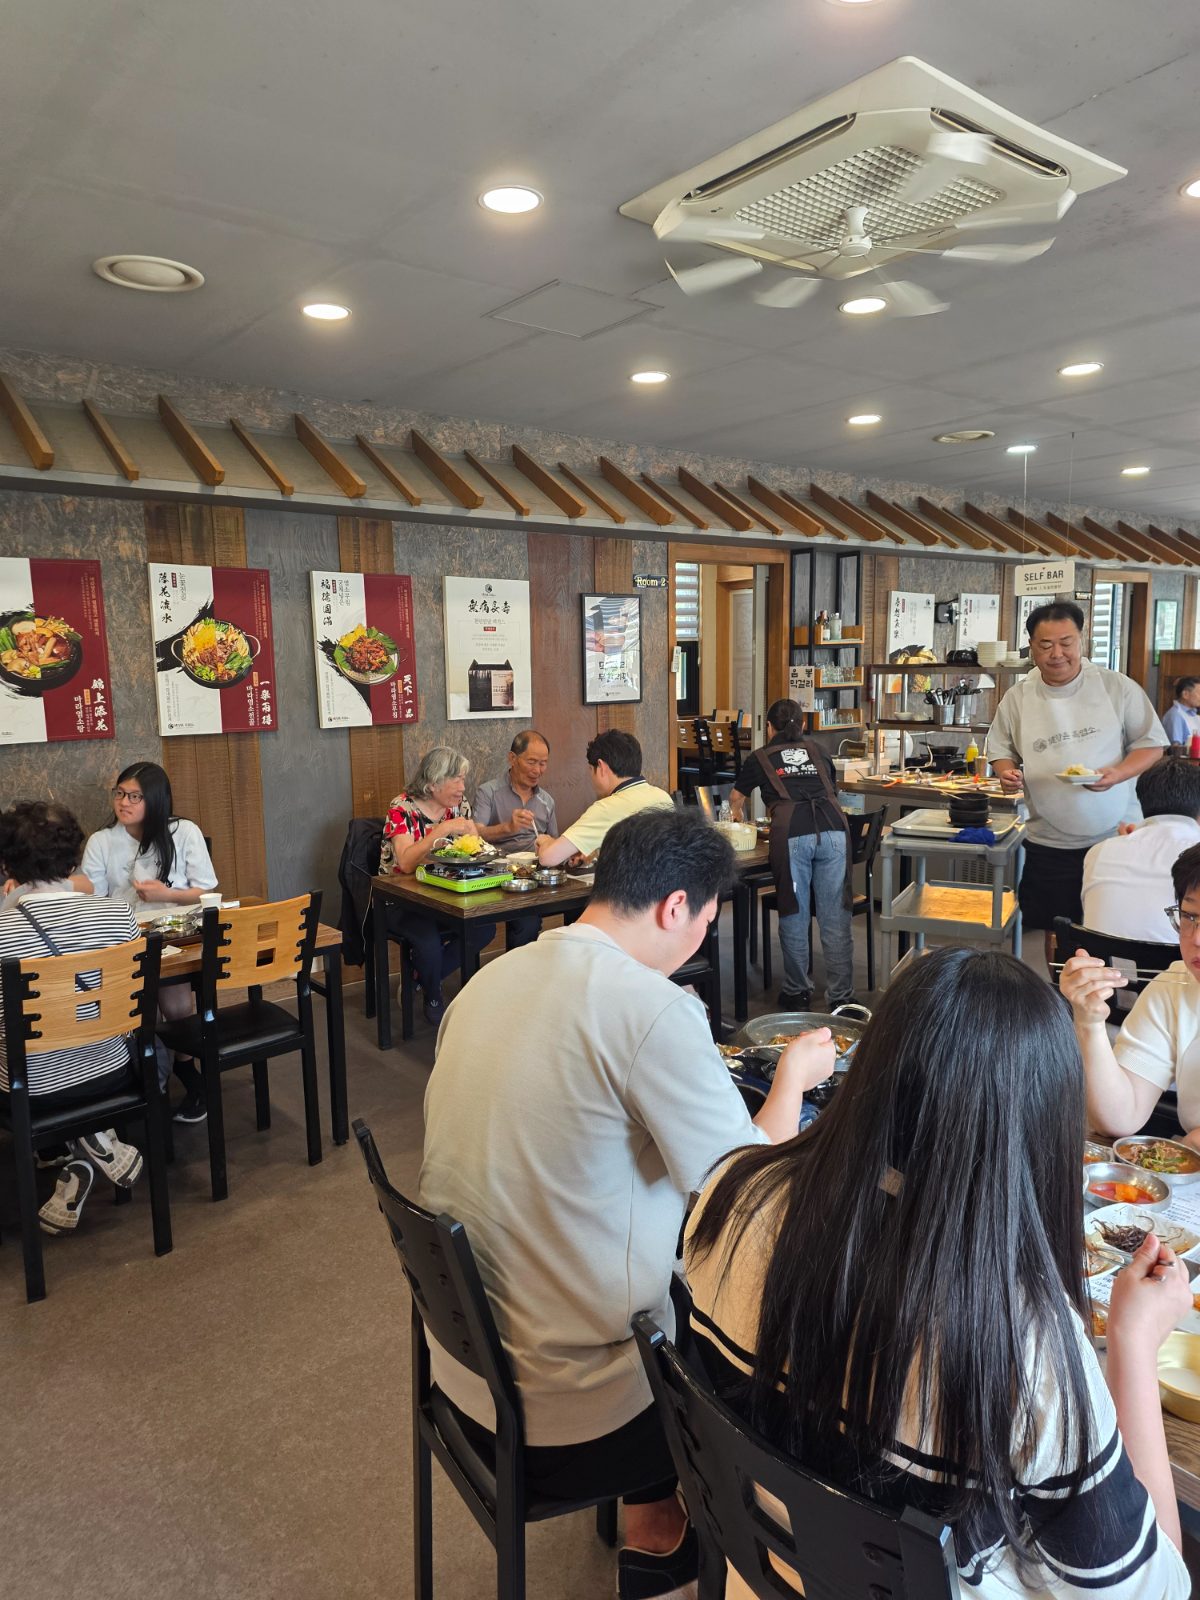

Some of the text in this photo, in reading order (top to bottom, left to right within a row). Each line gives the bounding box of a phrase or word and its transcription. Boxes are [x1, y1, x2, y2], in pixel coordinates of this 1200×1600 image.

[1024, 570, 1064, 581] SELF BAR
[637, 577, 666, 587] Room 2
[790, 679, 813, 689] 막걸리
